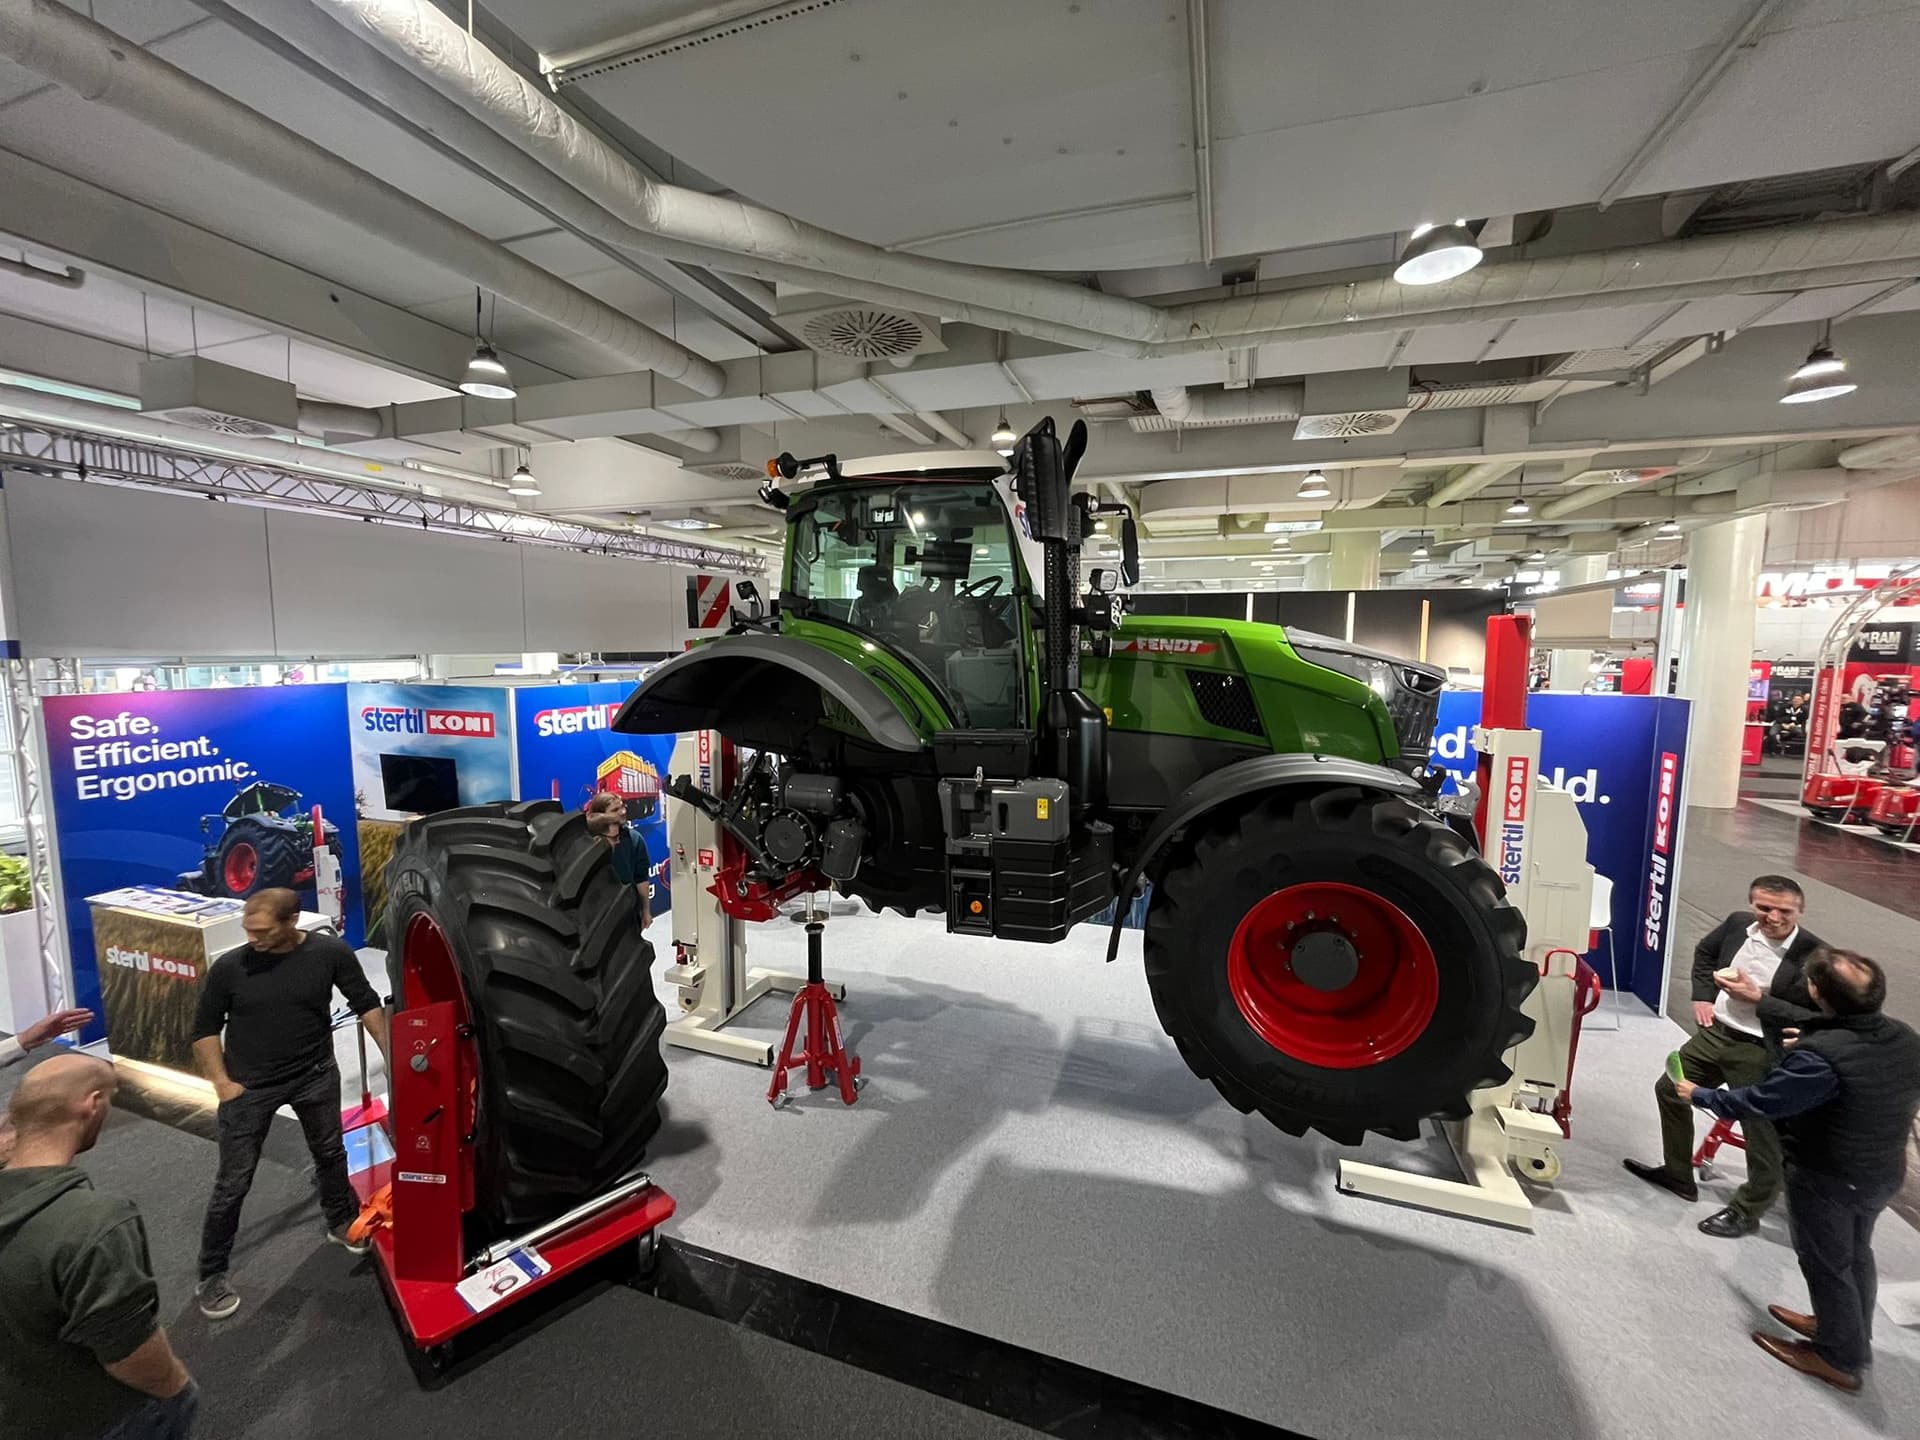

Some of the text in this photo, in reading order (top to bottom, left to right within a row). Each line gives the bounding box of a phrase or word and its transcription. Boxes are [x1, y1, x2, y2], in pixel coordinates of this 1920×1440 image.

[1137, 637, 1203, 653] FENDT
[70, 712, 160, 740] Safe,
[364, 708, 492, 734] stertil KONI
[537, 704, 606, 737] stertil
[73, 735, 219, 771] Efficient,
[76, 758, 257, 800] Ergonomic.
[1502, 760, 1525, 886] stertil KONI
[1645, 758, 1674, 951] stertil KONI
[106, 945, 197, 978] stertil KONI
